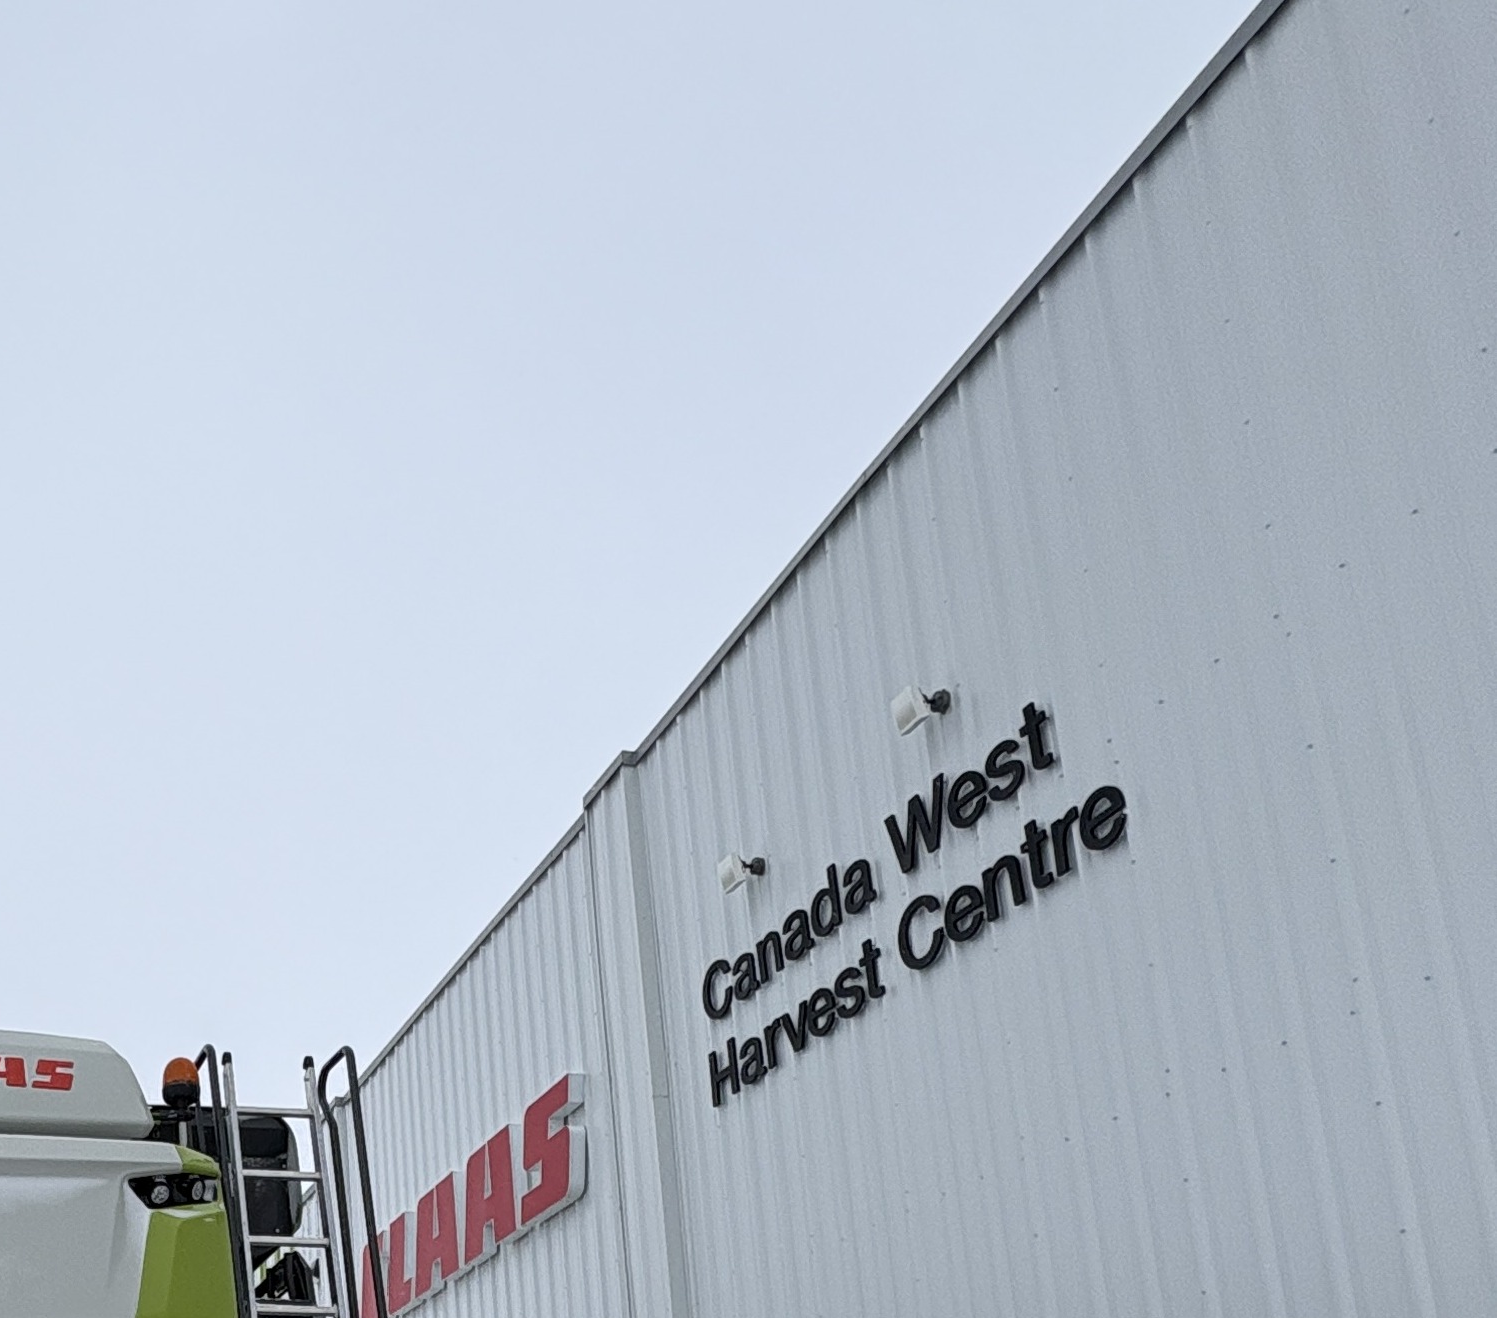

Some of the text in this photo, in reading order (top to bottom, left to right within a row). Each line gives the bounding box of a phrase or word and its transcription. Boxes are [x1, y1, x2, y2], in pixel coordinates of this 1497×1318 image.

[702, 701, 1055, 1020] Canada West
[707, 785, 1127, 1107] Harvest Centre
